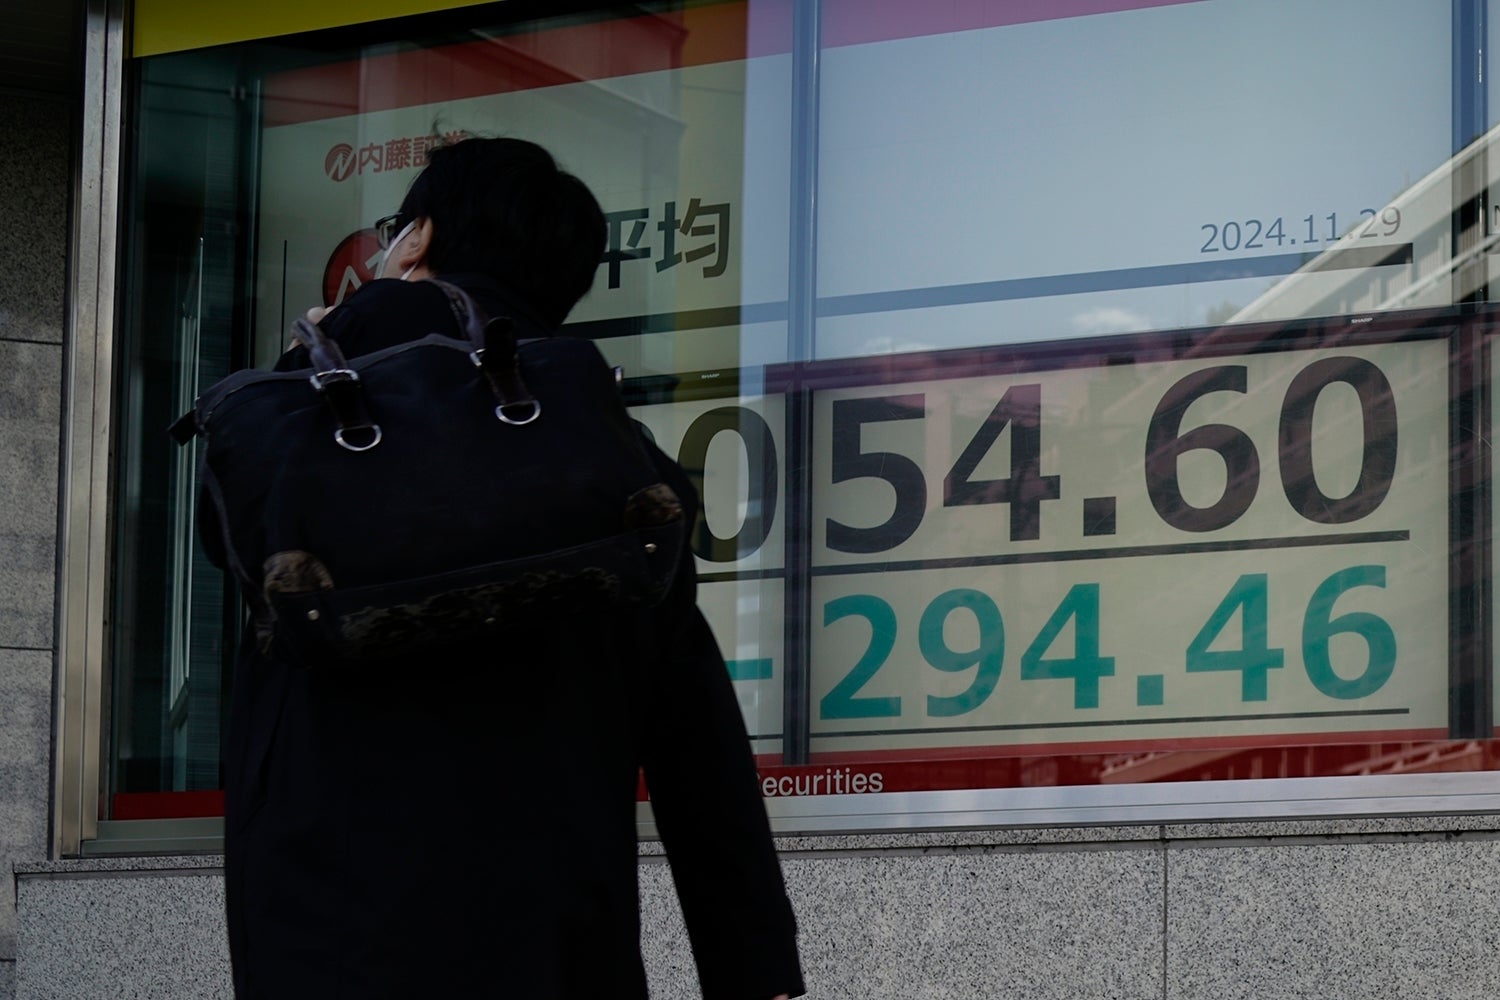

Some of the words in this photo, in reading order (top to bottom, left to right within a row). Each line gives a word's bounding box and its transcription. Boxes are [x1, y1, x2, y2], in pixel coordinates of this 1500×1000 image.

[600, 198, 730, 289] 平均
[1200, 206, 1402, 253] 2024.11.29
[757, 767, 883, 797] ecurities
